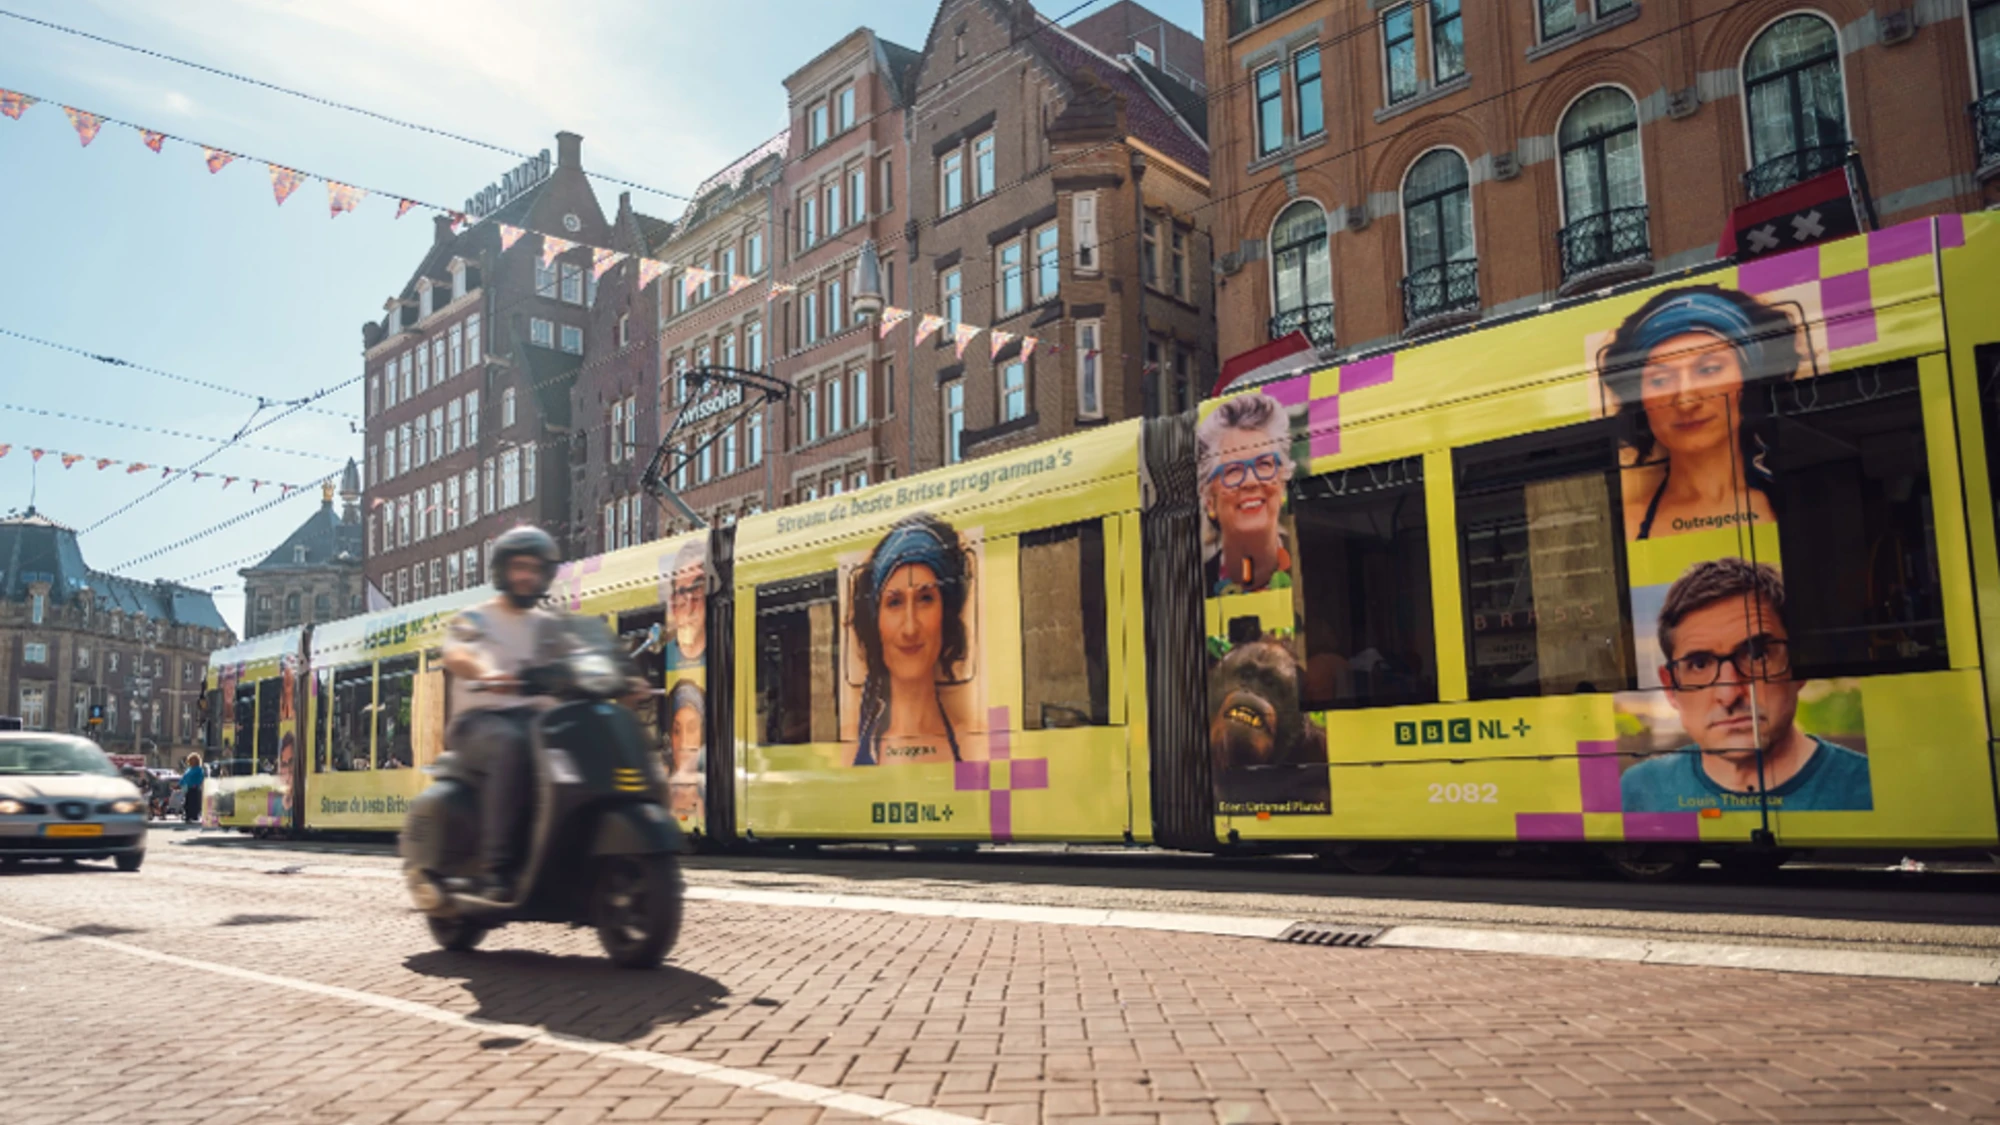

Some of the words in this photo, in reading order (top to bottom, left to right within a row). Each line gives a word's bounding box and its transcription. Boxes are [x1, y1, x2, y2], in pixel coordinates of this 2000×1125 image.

[777, 511, 826, 533] Stream
[829, 503, 847, 521] de
[851, 493, 893, 516] beste
[896, 480, 945, 505] Britse
[949, 448, 1073, 498] programma's
[1395, 718, 1472, 746] BBC
[1427, 782, 1499, 804] 2082
[1677, 794, 1718, 808] Louis
